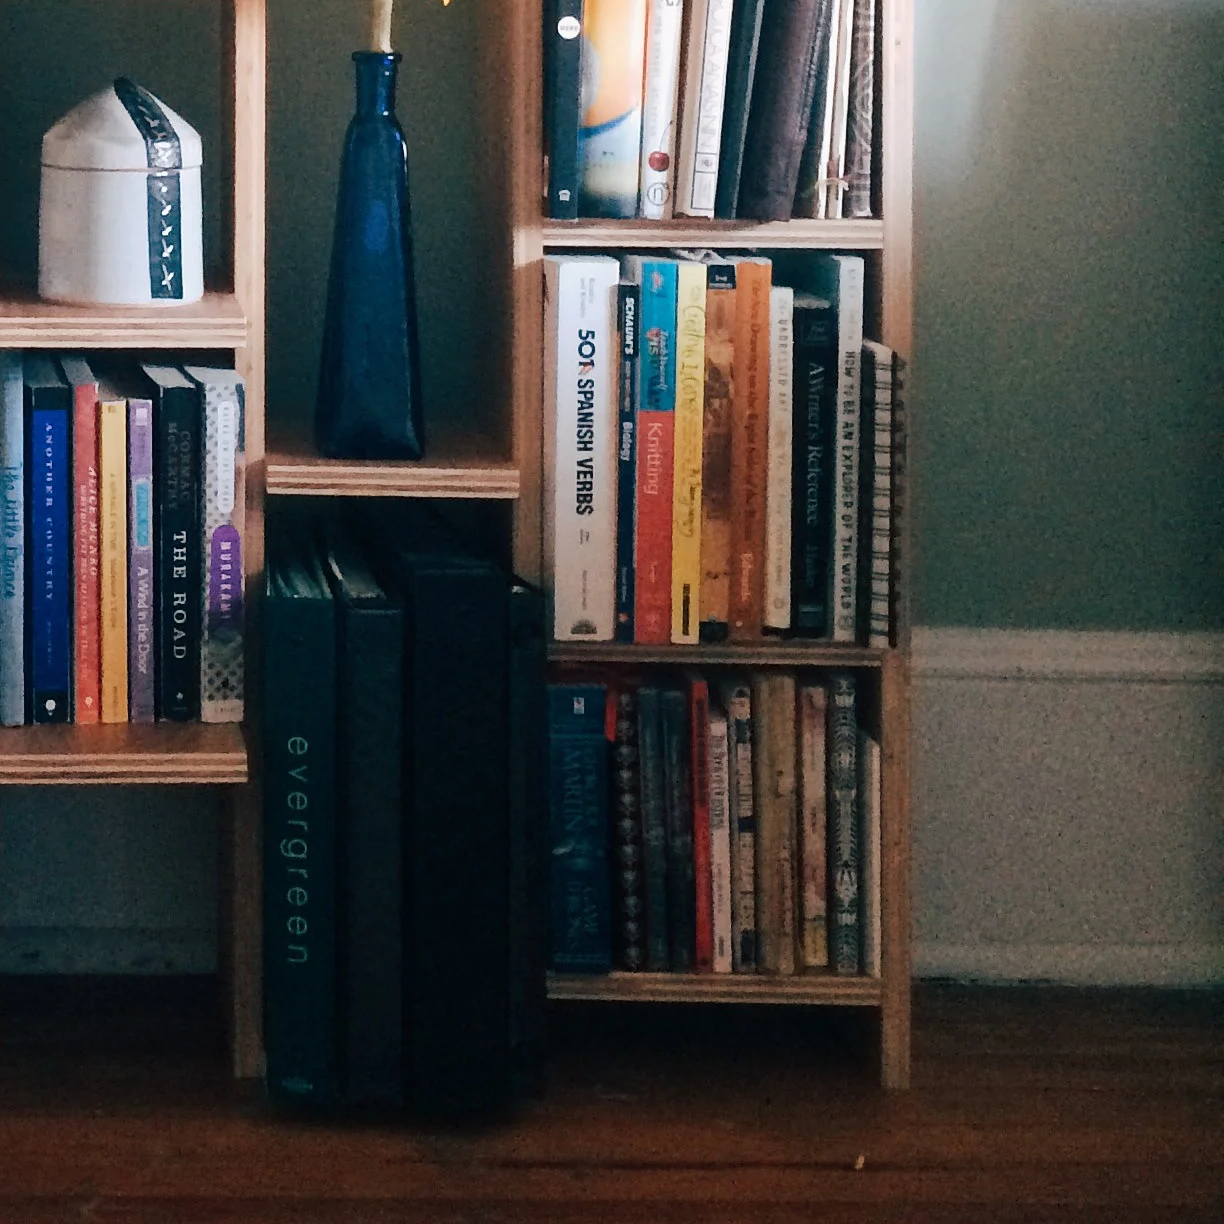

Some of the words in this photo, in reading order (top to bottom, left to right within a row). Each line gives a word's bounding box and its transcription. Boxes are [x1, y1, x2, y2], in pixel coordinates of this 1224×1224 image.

[578, 329, 596, 367] 501
[623, 297, 636, 355] SCHAUM'S
[845, 351, 856, 377] HOW
[576, 378, 595, 452] SPANISH
[842, 401, 854, 417] BE
[842, 421, 854, 441] AN
[45, 423, 54, 507] ANOTHER
[179, 430, 192, 500] CORMAC
[620, 421, 632, 461] Biology
[643, 422, 662, 495] Knitting
[3, 466, 22, 491] The
[88, 466, 98, 514] ALICE
[167, 421, 179, 511] McCARTHY
[576, 458, 594, 515] VERBS
[806, 445, 824, 525] Reference
[841, 445, 854, 509] EXPLORER
[841, 514, 852, 531] OF
[44, 517, 54, 601] COUNTRY
[88, 521, 98, 576] MUNRO
[172, 530, 187, 579] THE
[841, 535, 852, 559] THE
[137, 567, 149, 576] A
[137, 580, 148, 608] Wind
[841, 563, 852, 609] WORLD
[137, 612, 148, 620] in
[137, 624, 149, 642] the
[172, 592, 187, 659] ROAD
[138, 644, 149, 674] Door
[280, 735, 311, 965] evergreen
